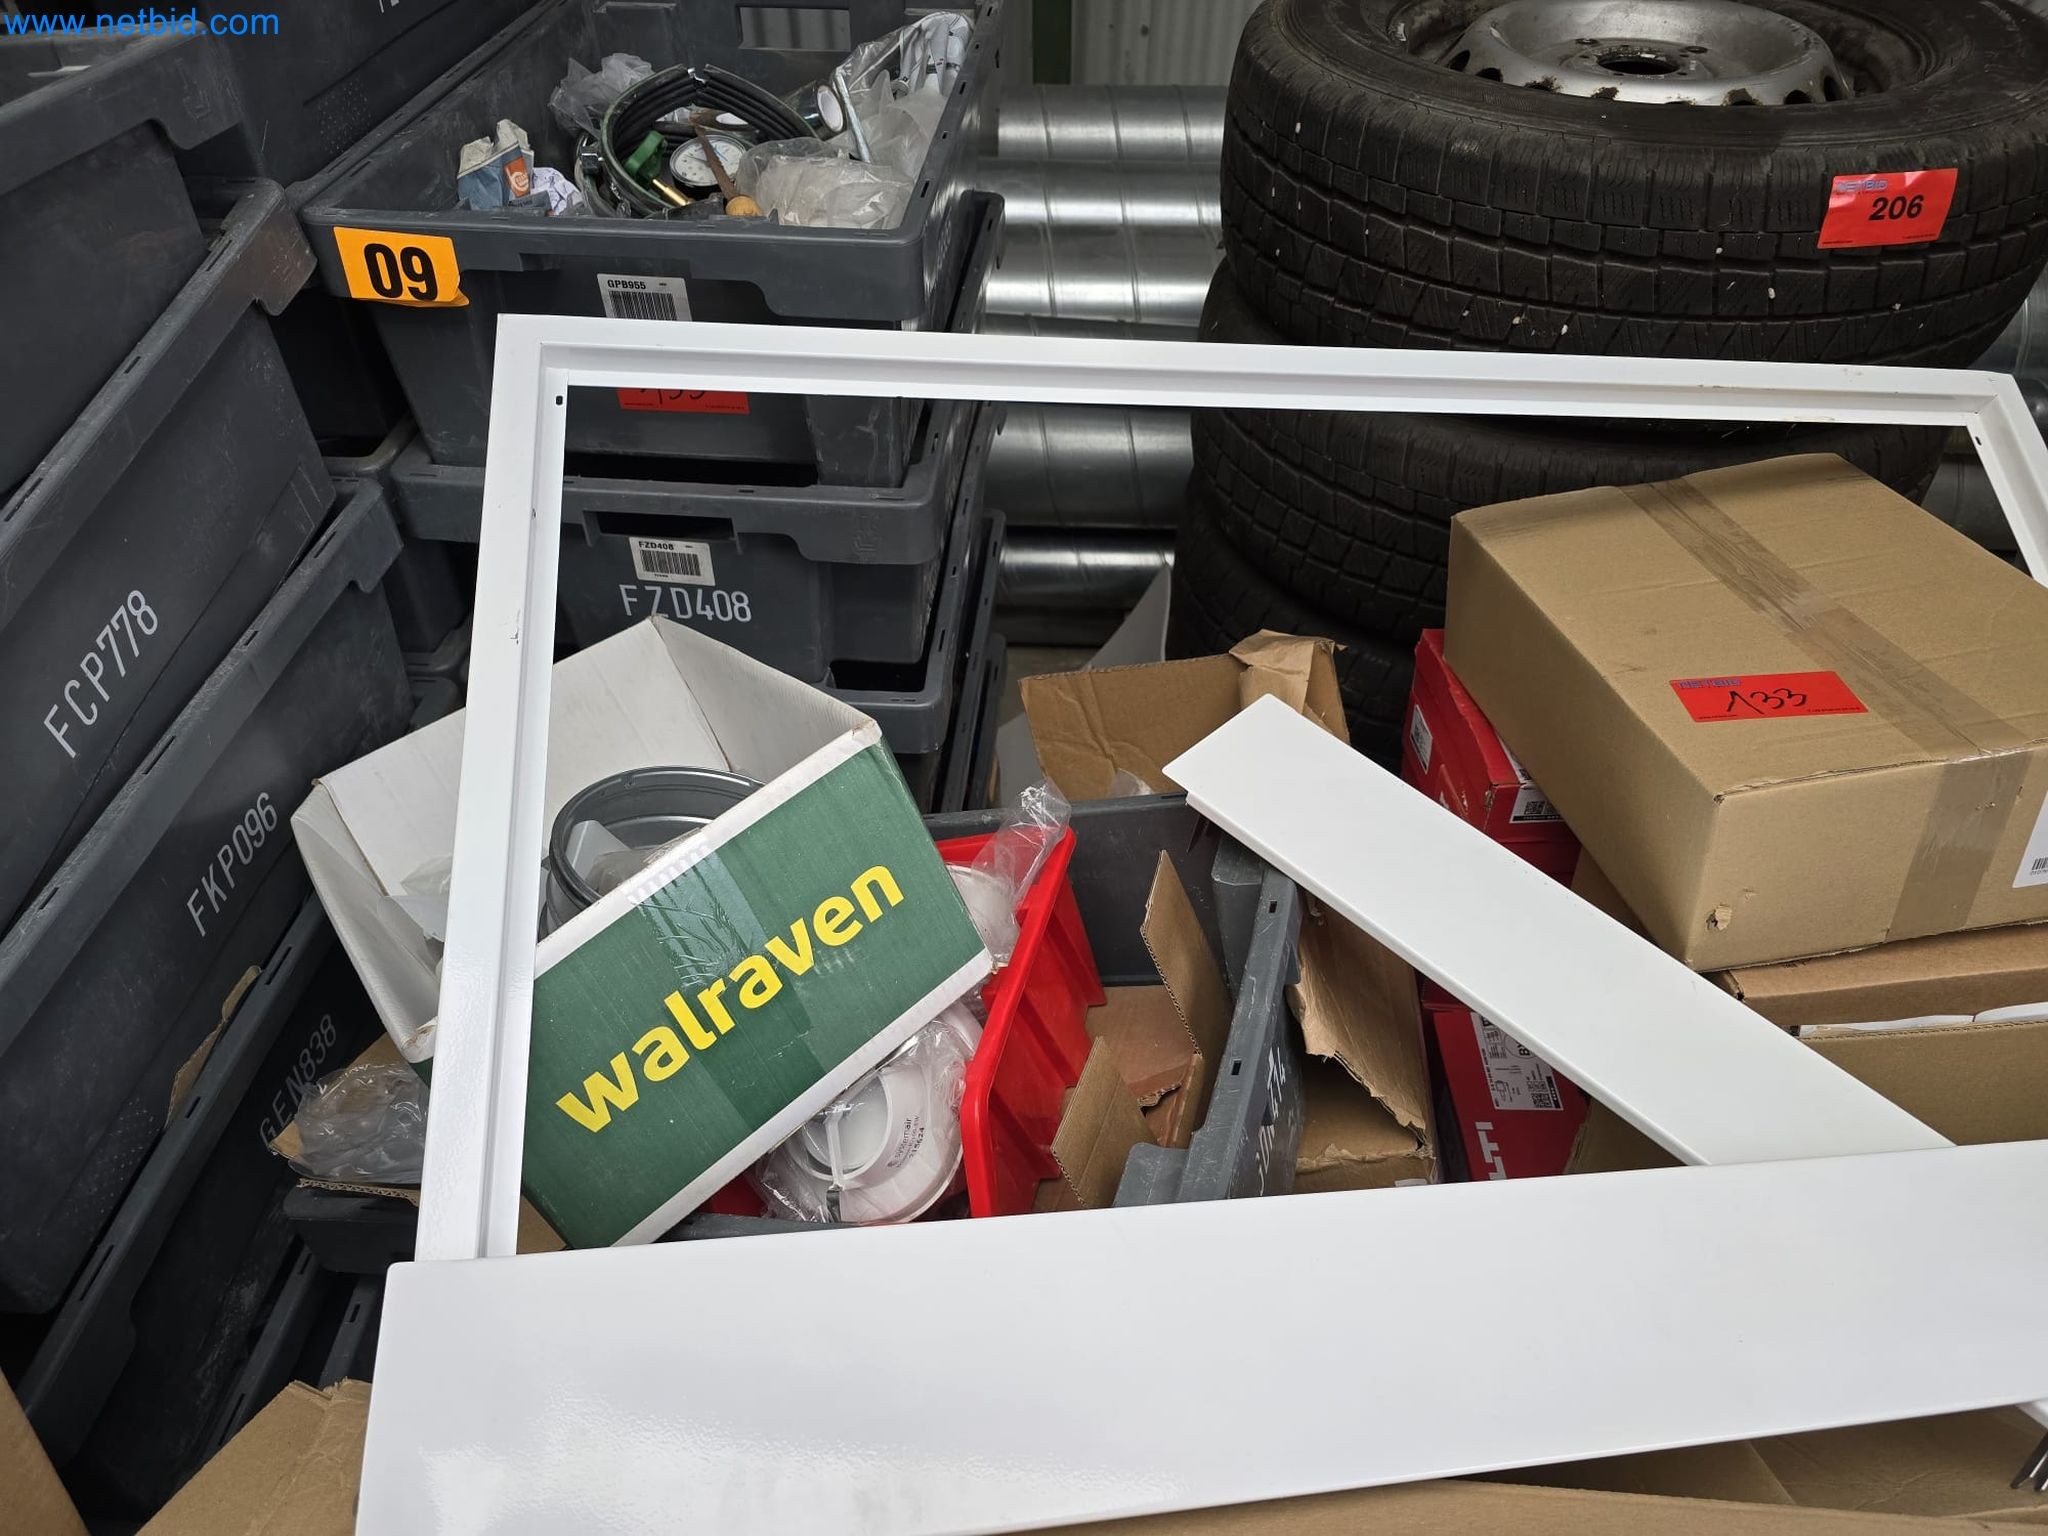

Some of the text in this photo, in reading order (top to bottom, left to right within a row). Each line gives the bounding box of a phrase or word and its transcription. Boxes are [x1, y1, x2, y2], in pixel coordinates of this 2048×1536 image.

[1868, 195, 1924, 221] 206
[364, 243, 438, 301] 09
[607, 279, 647, 290] GPB955
[638, 540, 675, 550] FZD408
[619, 584, 752, 622] FZD408
[43, 590, 158, 759] FCP778
[186, 792, 278, 937] FKP096
[555, 865, 904, 1133] walraven
[1475, 1121, 1508, 1181] LTI
